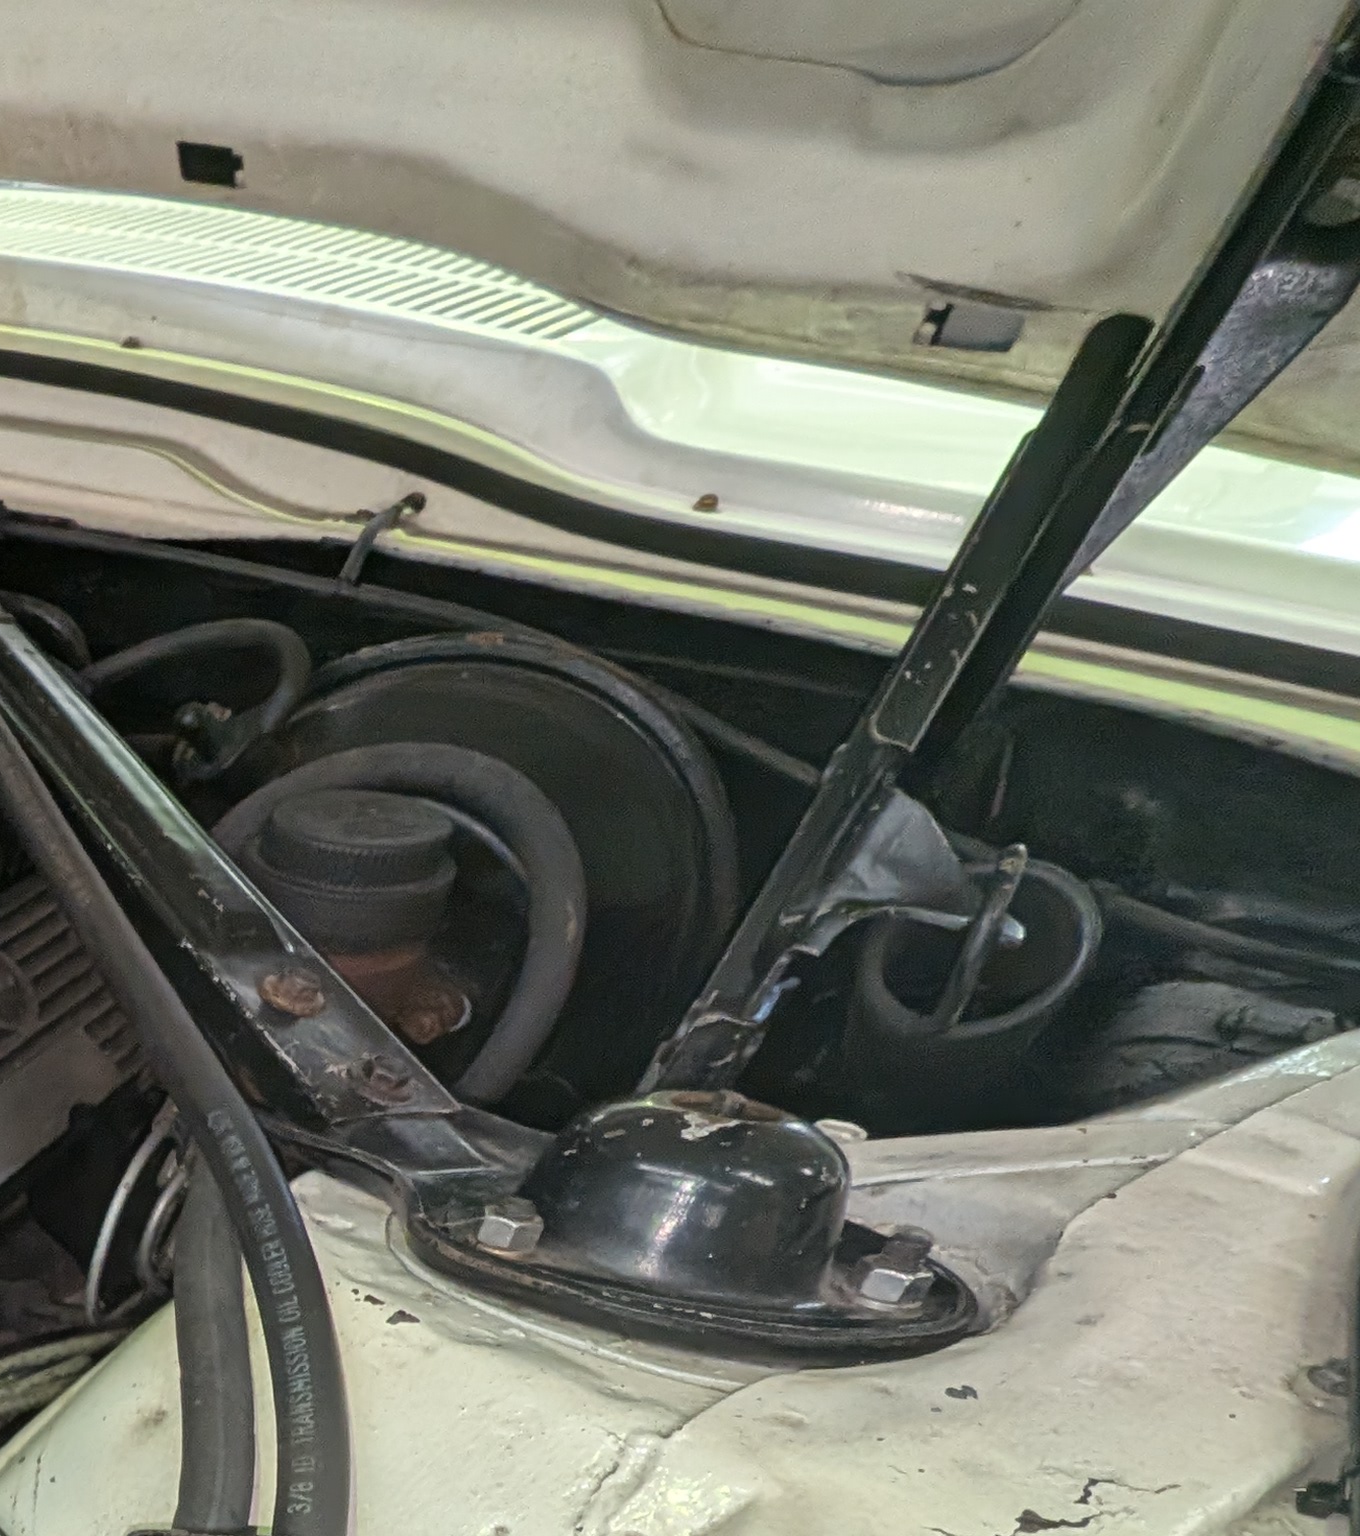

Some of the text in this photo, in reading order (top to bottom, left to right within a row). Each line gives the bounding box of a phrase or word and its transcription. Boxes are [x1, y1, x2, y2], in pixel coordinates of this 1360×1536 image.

[274, 1295, 302, 1323] OIL
[281, 1325, 316, 1446] TRANSMISSION
[293, 1455, 316, 1473] ID
[287, 1480, 314, 1514] 3/8
